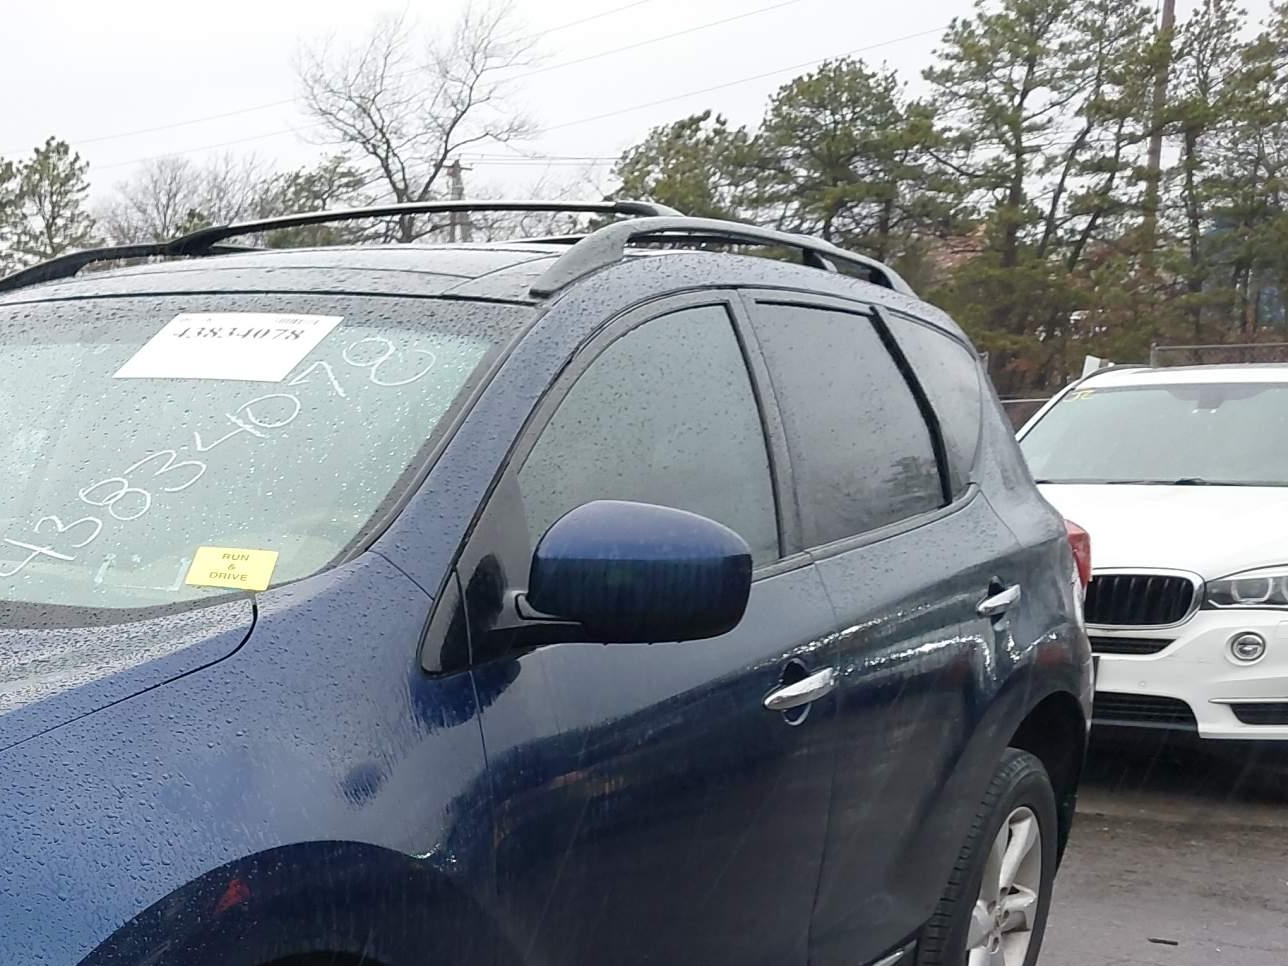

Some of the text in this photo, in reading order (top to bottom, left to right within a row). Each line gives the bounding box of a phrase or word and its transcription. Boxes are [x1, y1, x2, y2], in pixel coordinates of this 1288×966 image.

[173, 327, 305, 340] 43834078
[222, 553, 250, 561] RUN
[209, 571, 248, 582] DRIVE
